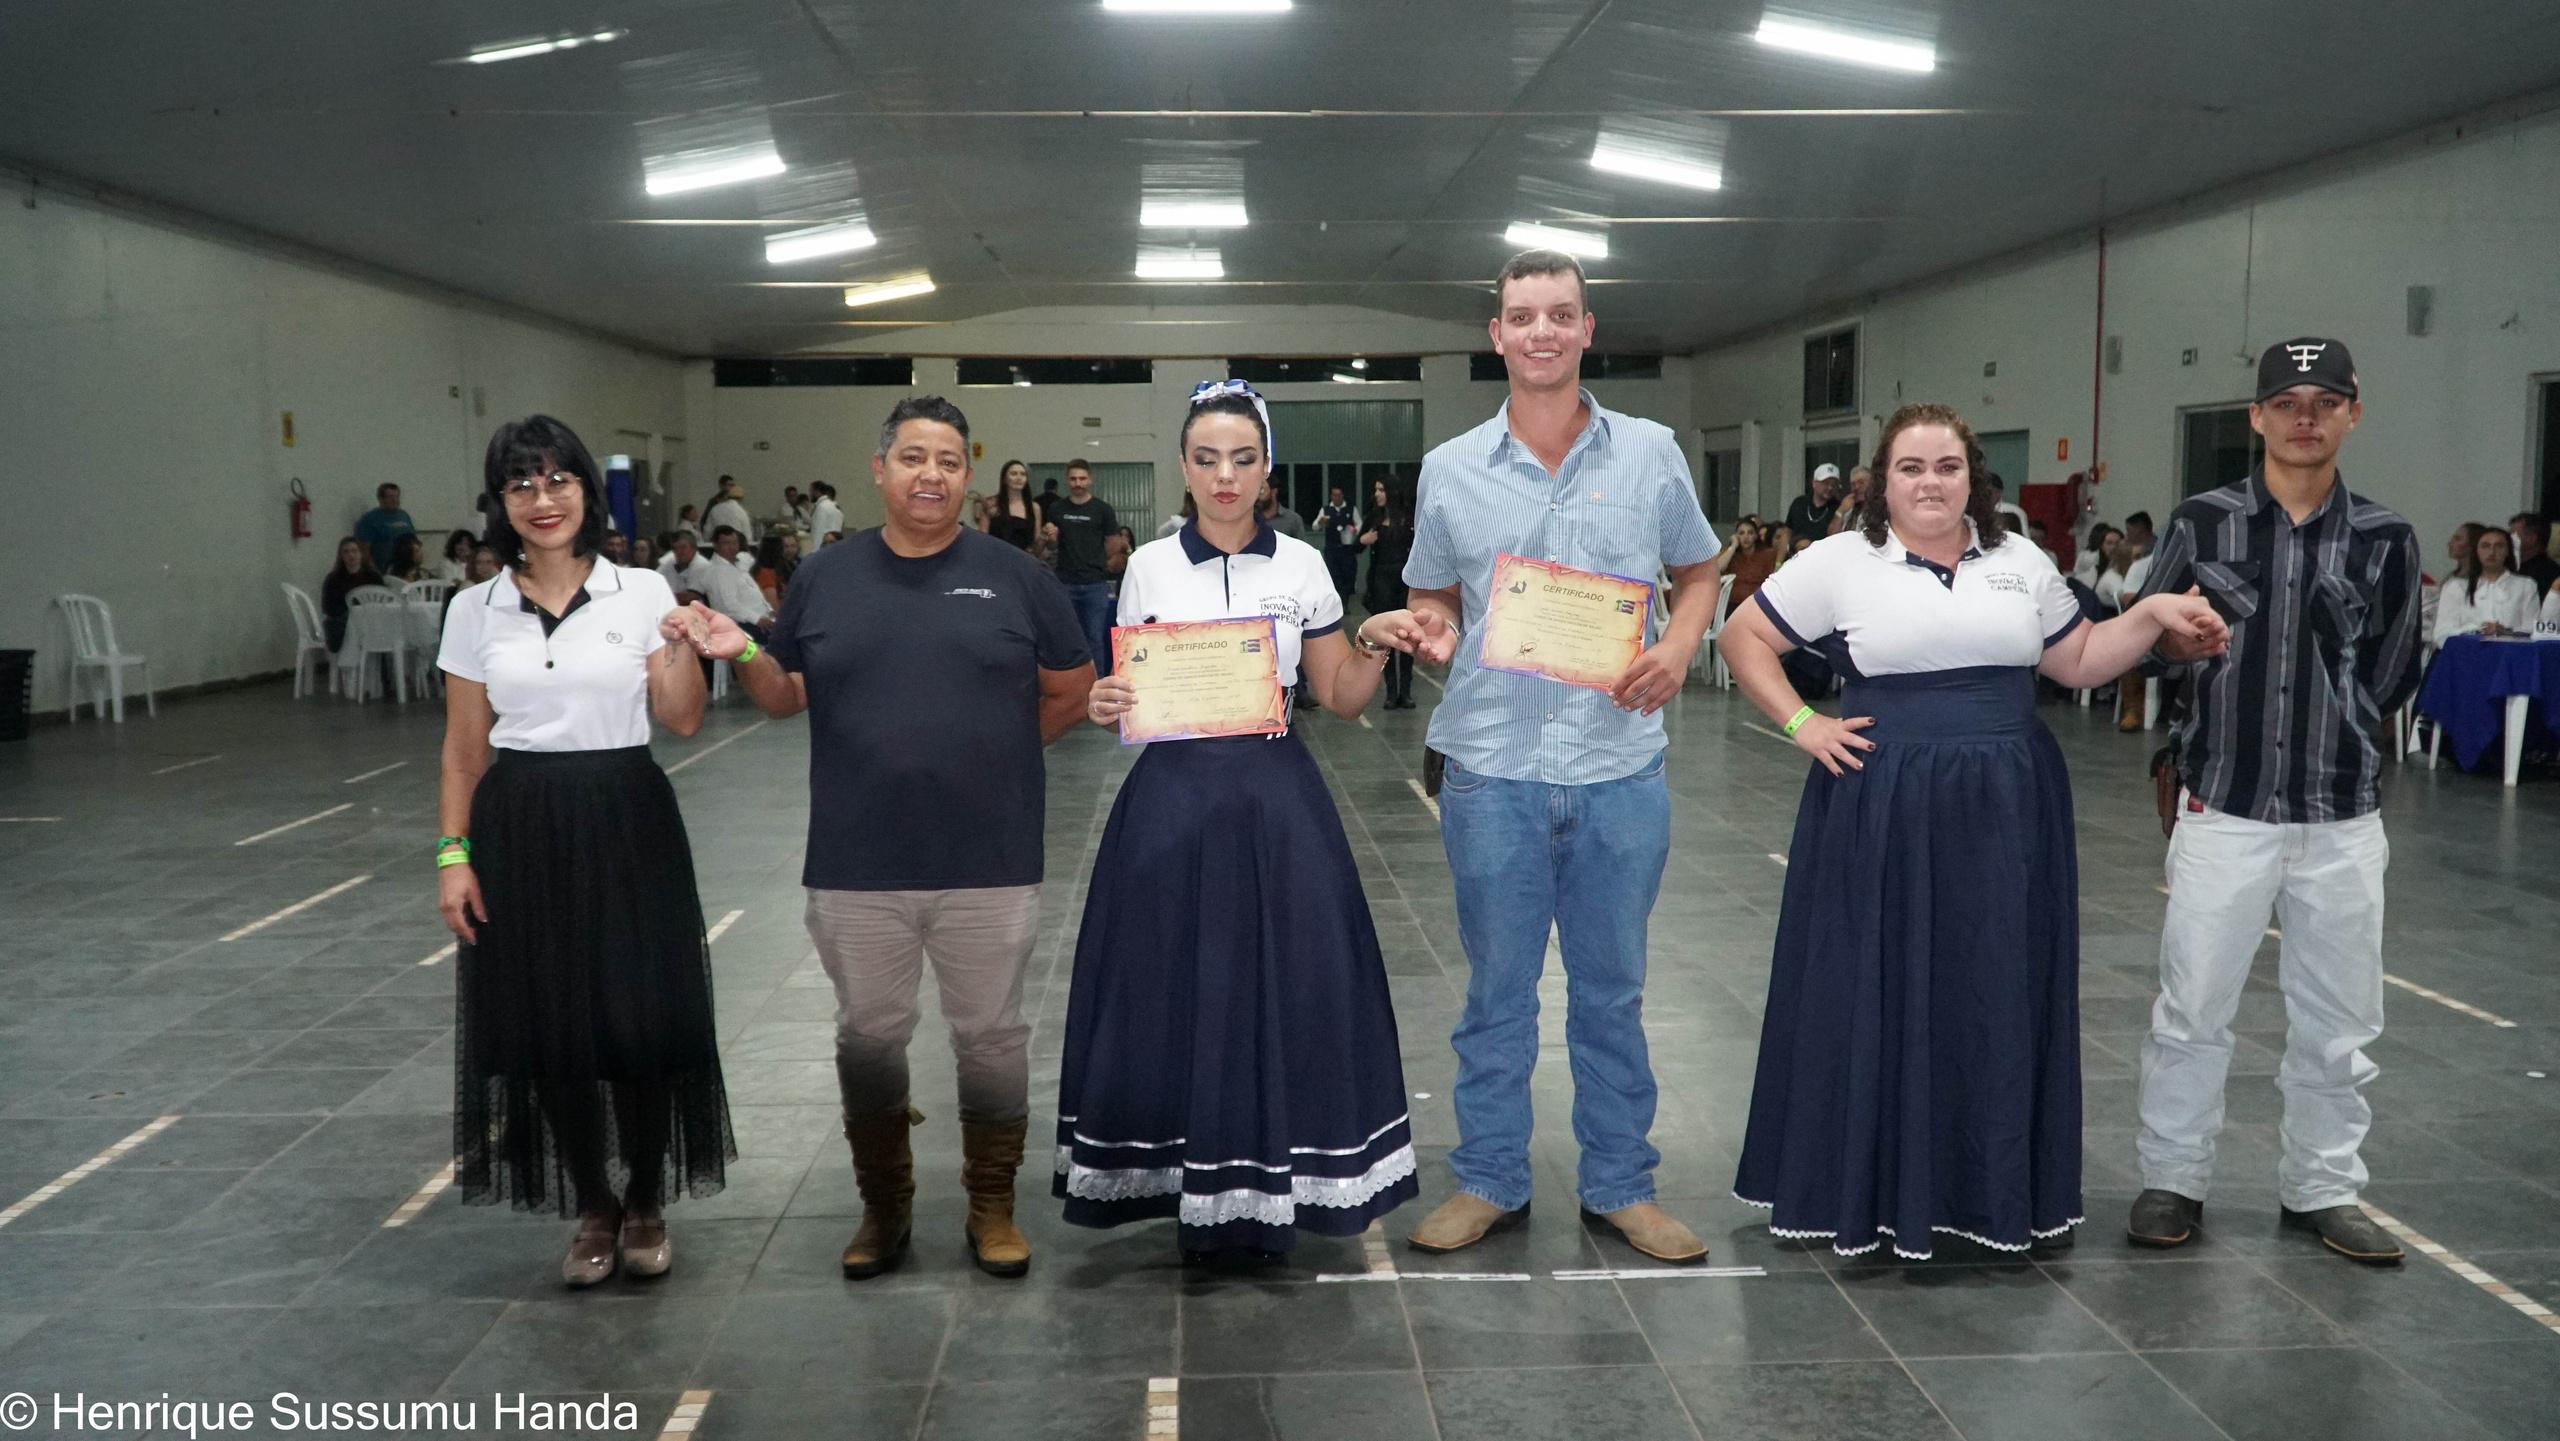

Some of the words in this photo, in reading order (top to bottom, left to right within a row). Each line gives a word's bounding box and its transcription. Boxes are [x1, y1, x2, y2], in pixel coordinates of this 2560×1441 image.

[1543, 584, 1605, 602] CERTIFICADO
[2536, 621, 2556, 634] 09
[1165, 640, 1228, 653] CERTIFICADO
